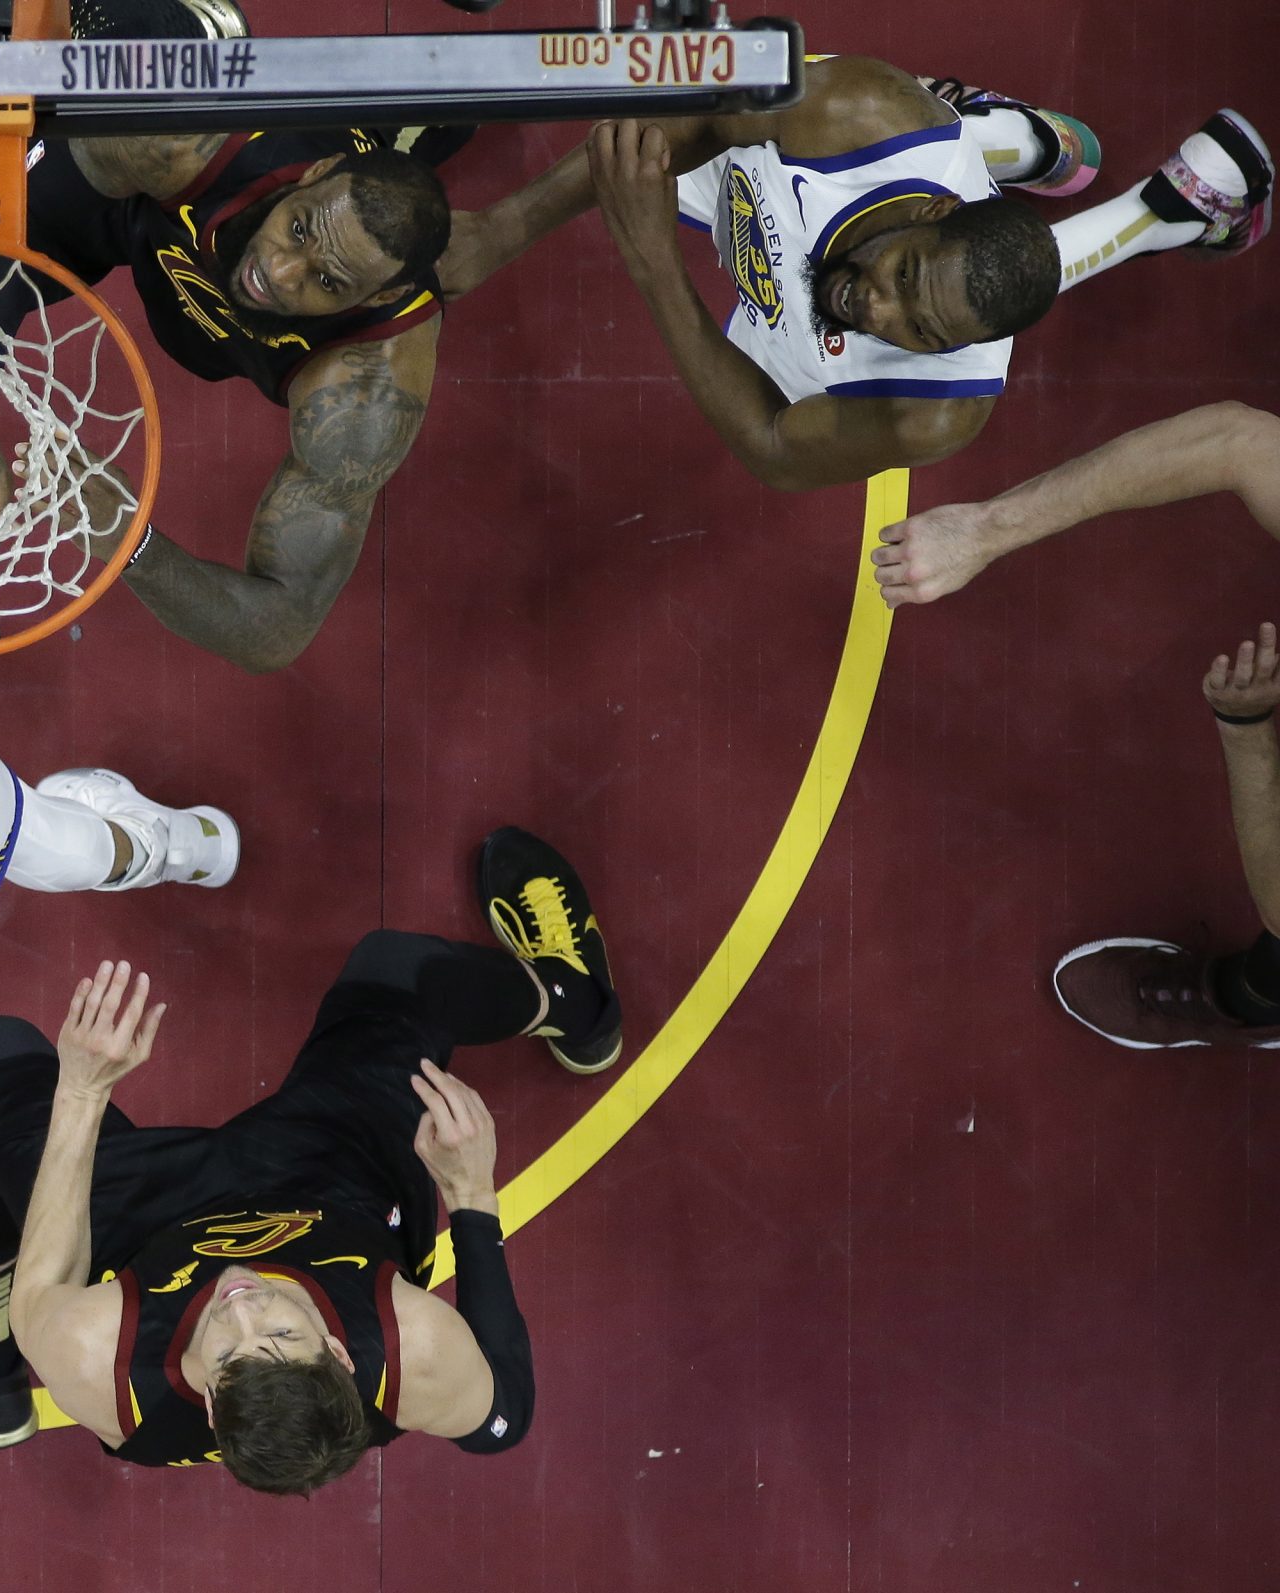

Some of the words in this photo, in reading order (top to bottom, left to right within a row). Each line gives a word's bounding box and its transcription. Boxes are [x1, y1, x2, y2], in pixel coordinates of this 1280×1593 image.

[61, 43, 257, 90] #NBAFINALS
[539, 33, 736, 87] CAVS.com
[752, 167, 783, 267] GOLDEN
[750, 245, 777, 306] 35
